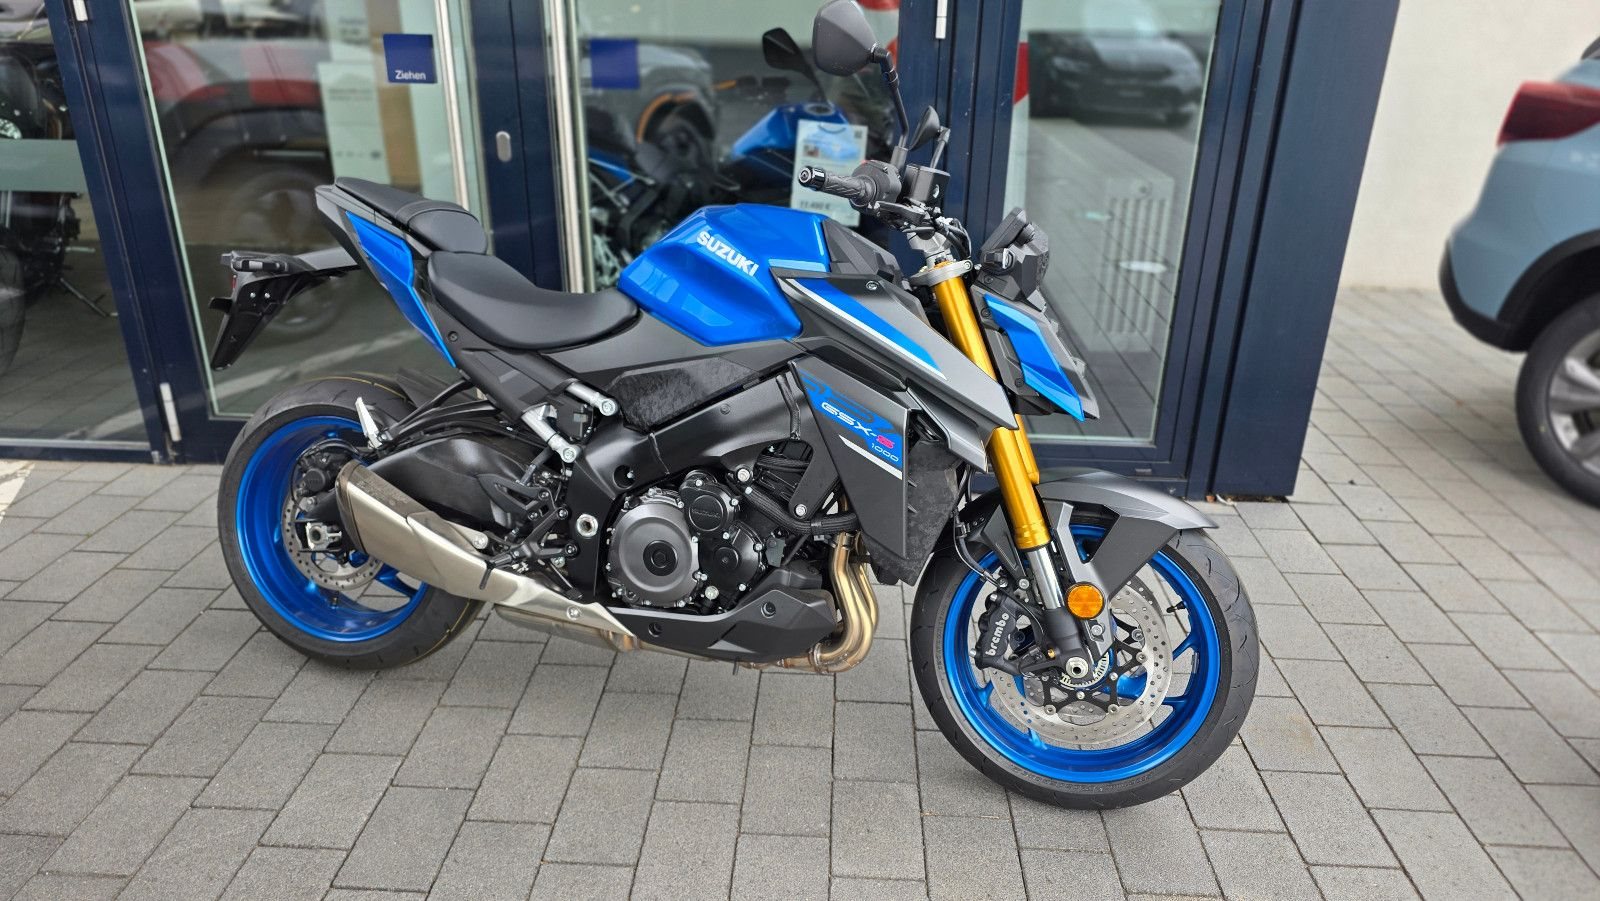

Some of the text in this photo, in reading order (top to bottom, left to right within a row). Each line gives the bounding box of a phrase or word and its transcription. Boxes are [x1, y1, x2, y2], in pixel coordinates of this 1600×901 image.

[395, 70, 427, 80] Ziehen
[697, 230, 759, 277] SUZUKI
[821, 402, 895, 449] GSX-S
[871, 442, 899, 462] 1000
[985, 612, 1010, 657] brembo
